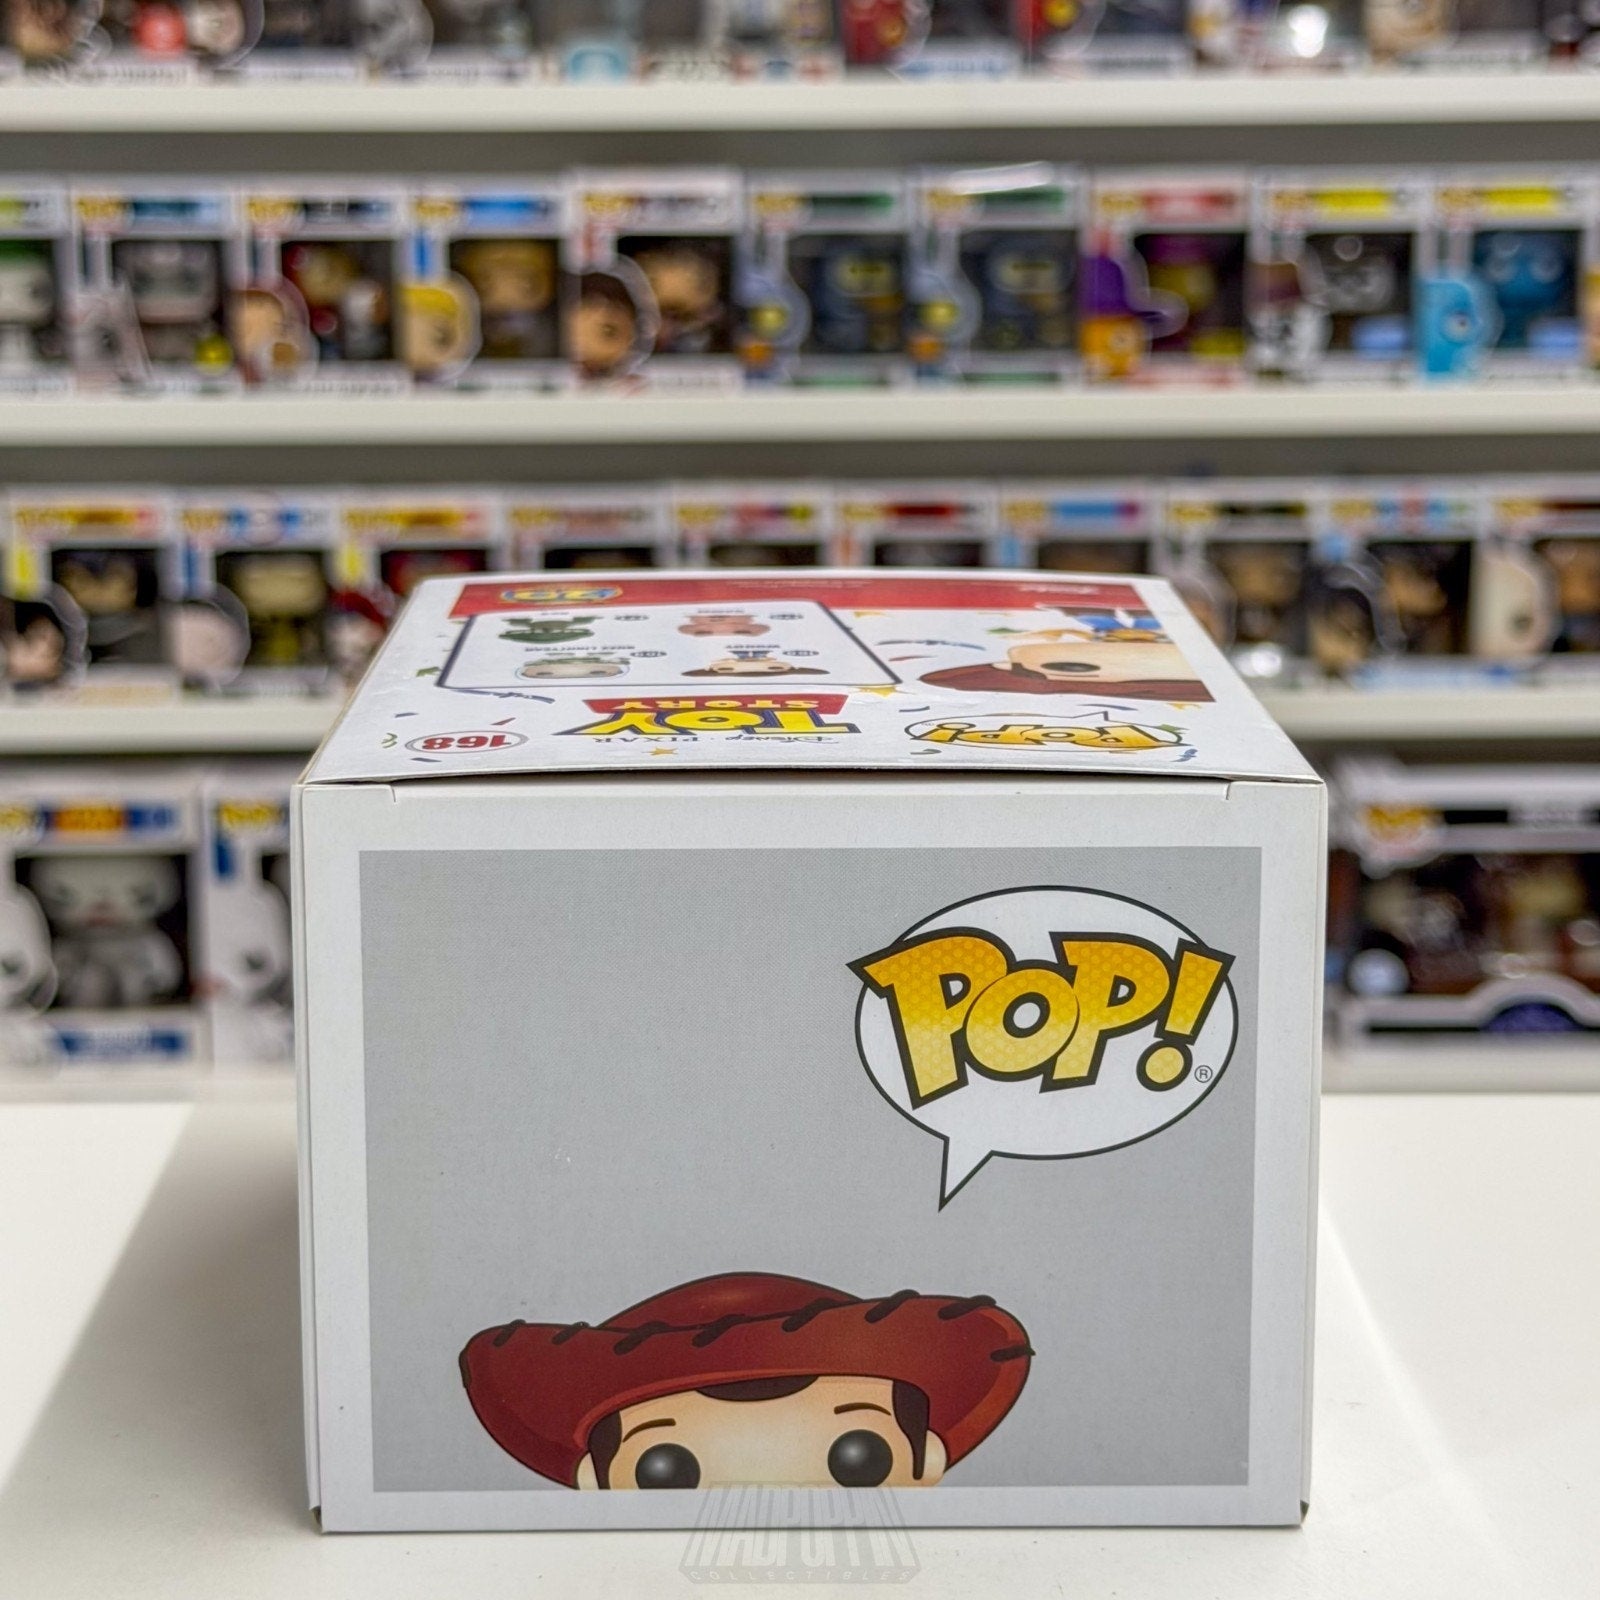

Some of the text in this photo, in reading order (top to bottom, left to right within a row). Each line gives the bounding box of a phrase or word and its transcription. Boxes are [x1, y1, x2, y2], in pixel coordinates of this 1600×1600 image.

[609, 700, 820, 709] STORY
[551, 709, 862, 735] TOY
[421, 735, 512, 750] 168
[725, 735, 840, 744] Disney
[910, 723, 1193, 749] POP!
[845, 926, 1237, 1111] POP!
